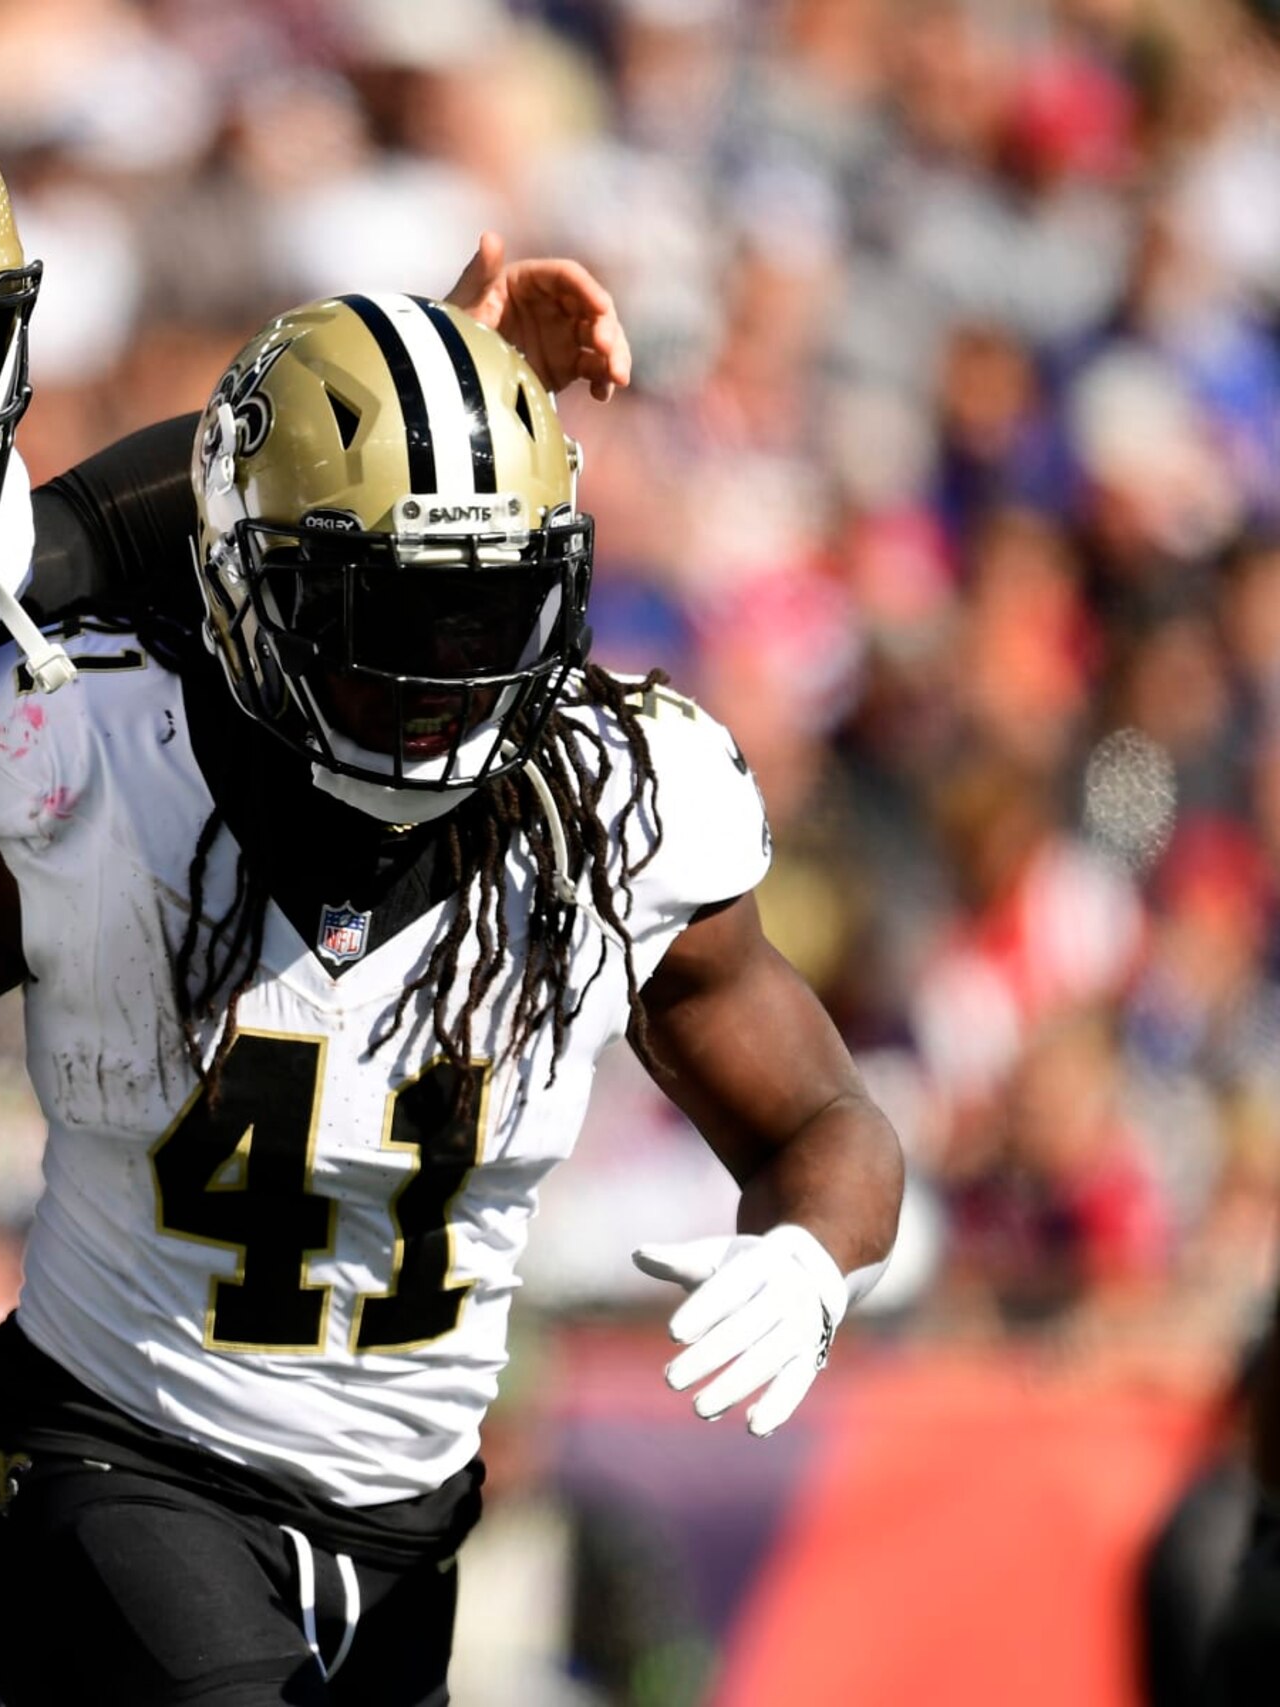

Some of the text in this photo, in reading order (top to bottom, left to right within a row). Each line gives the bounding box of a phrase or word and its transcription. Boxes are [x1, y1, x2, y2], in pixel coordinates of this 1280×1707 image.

[305, 516, 354, 531] OAKLEY
[429, 505, 492, 524] SAINTS
[147, 1025, 494, 1356] 41
